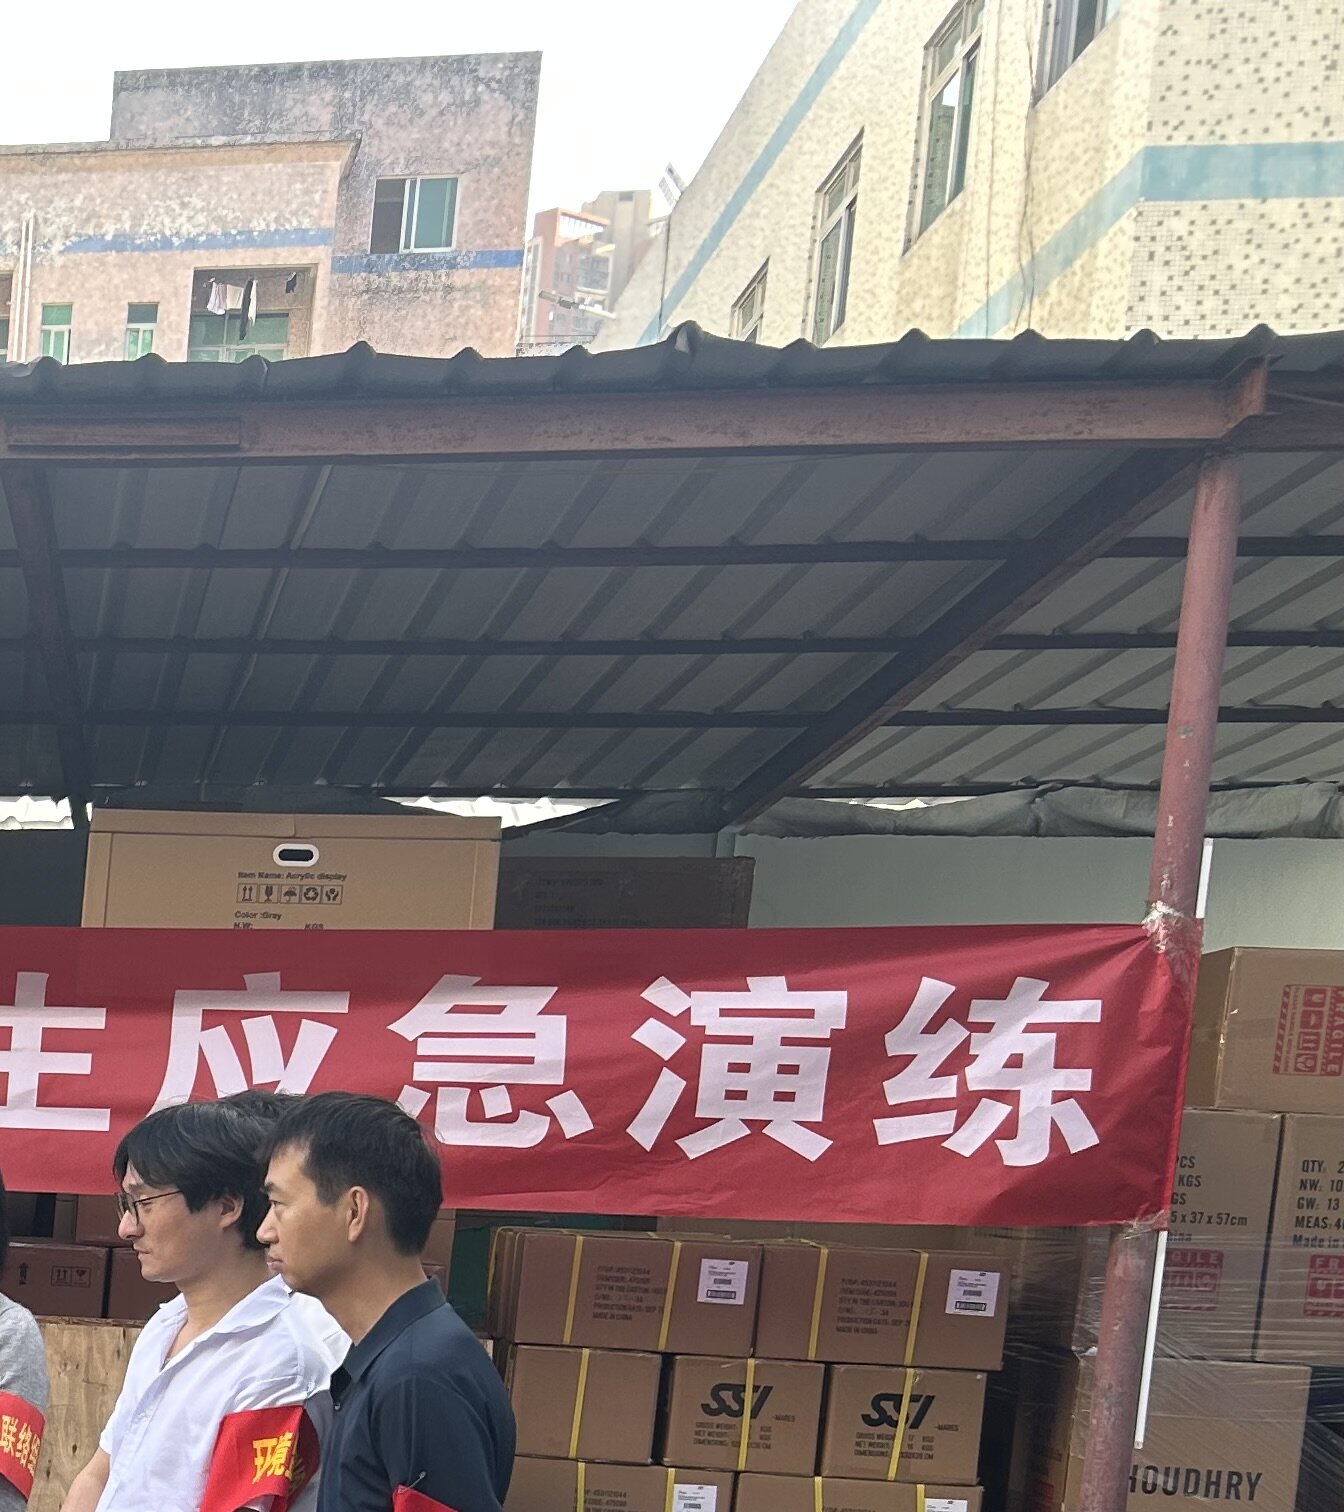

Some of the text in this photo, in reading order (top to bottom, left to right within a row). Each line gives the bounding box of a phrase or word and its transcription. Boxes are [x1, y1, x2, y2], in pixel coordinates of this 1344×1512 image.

[1178, 1156, 1195, 1168] CS
[1178, 1174, 1202, 1187] KGS
[1171, 1192, 1186, 1205] GS
[1328, 1198, 1340, 1210] 13
[1190, 1212, 1204, 1224] 37
[1216, 1213, 1247, 1226] 57cm
